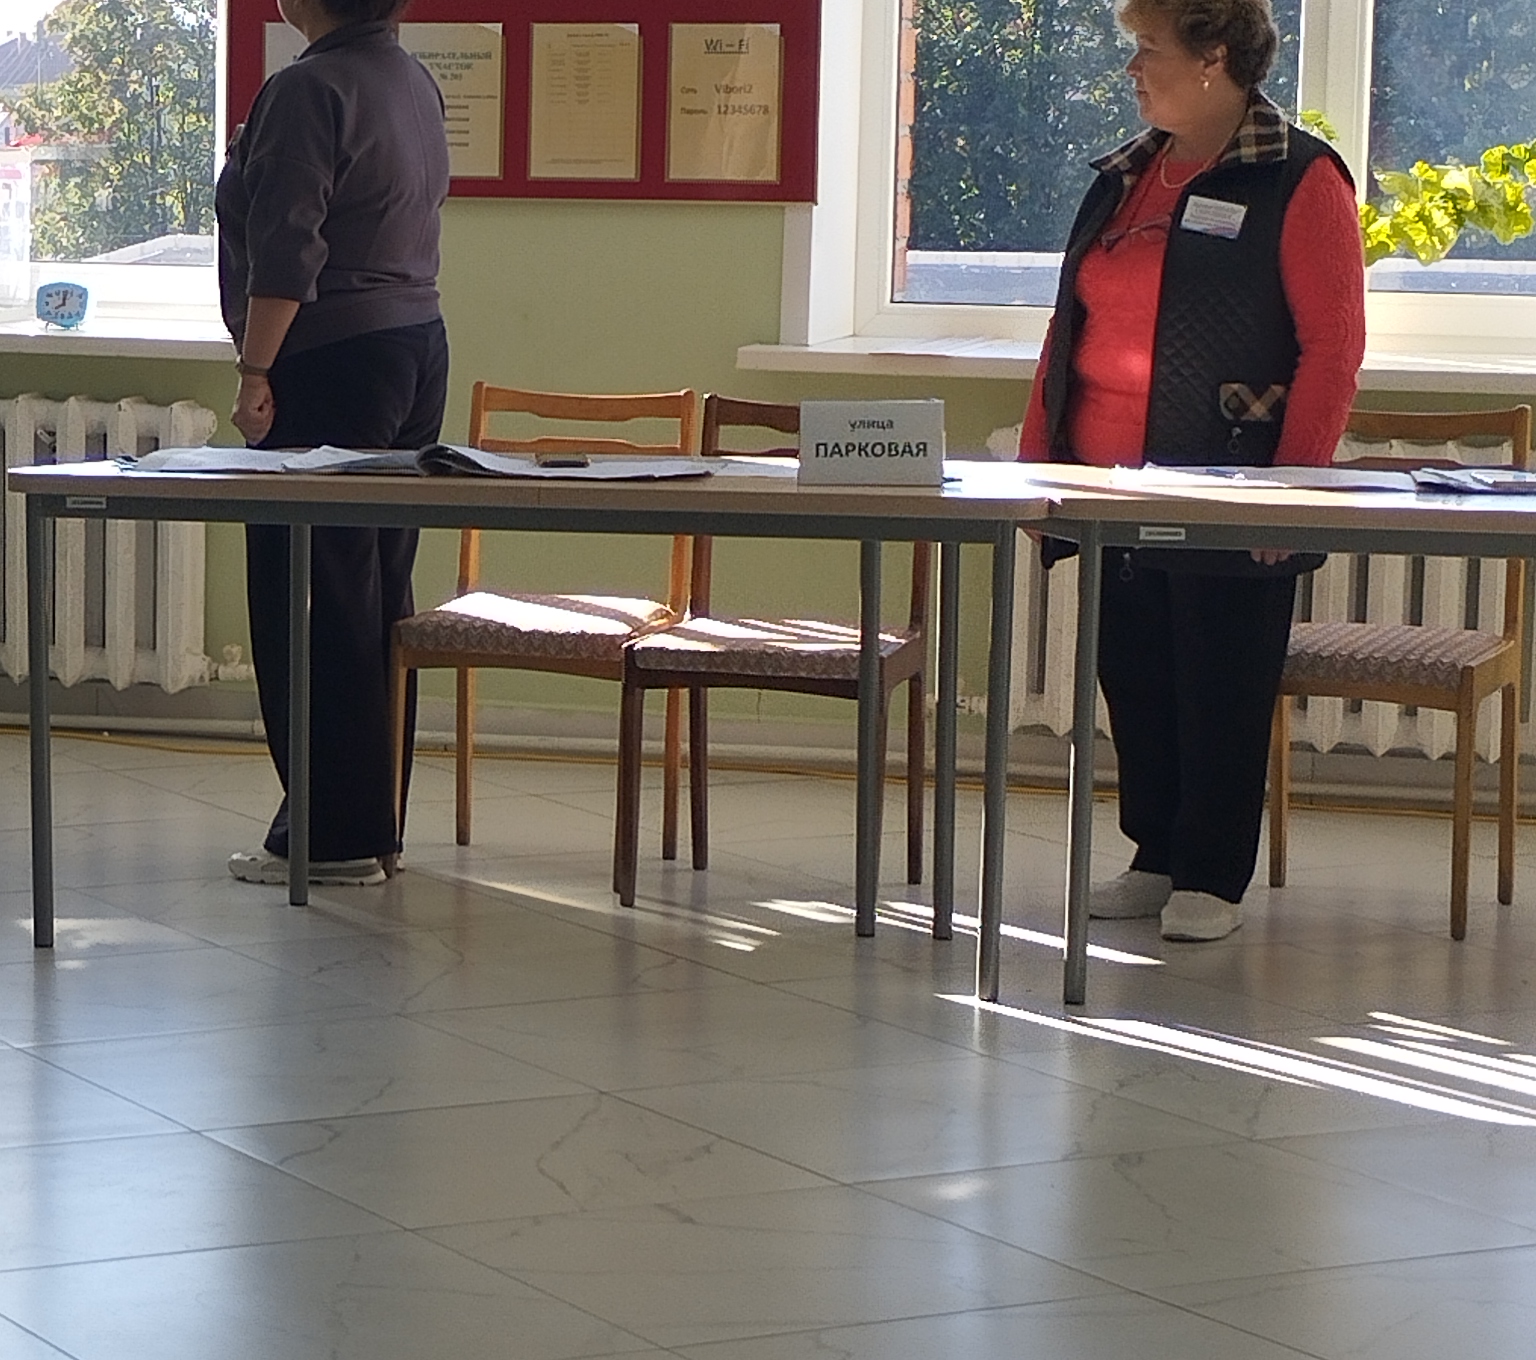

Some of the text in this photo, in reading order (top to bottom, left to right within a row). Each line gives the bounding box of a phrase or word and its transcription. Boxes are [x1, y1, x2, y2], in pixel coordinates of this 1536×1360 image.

[717, 103, 770, 116] 12345678
[848, 419, 894, 432] улица
[815, 442, 928, 458] ПАРКОВАЯ
